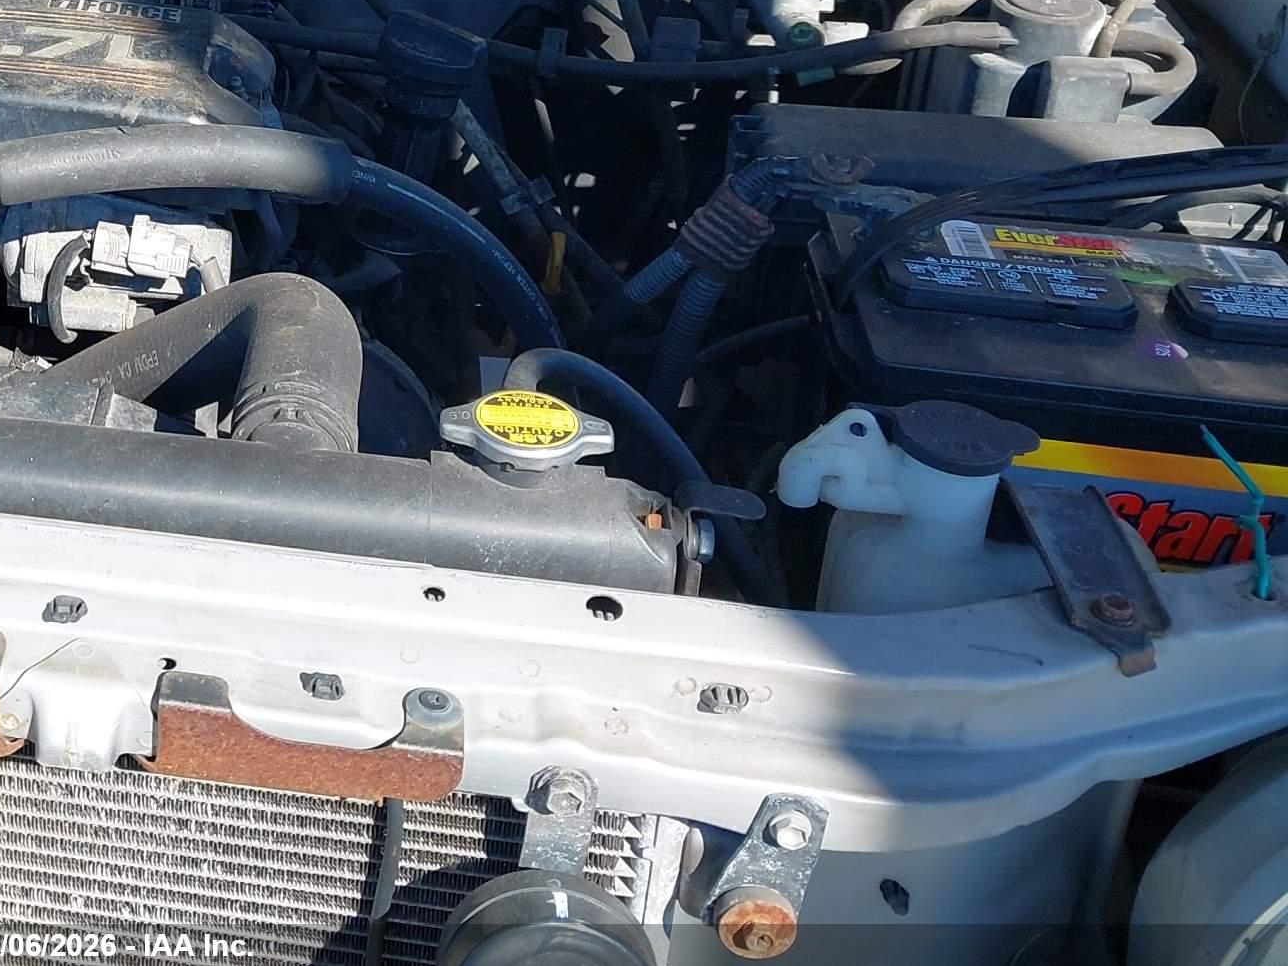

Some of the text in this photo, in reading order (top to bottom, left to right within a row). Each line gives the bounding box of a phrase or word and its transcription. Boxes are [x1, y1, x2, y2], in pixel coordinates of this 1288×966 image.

[939, 256, 1002, 270] DANGER
[1017, 264, 1074, 276] POISON
[493, 425, 565, 438] CAUTION
